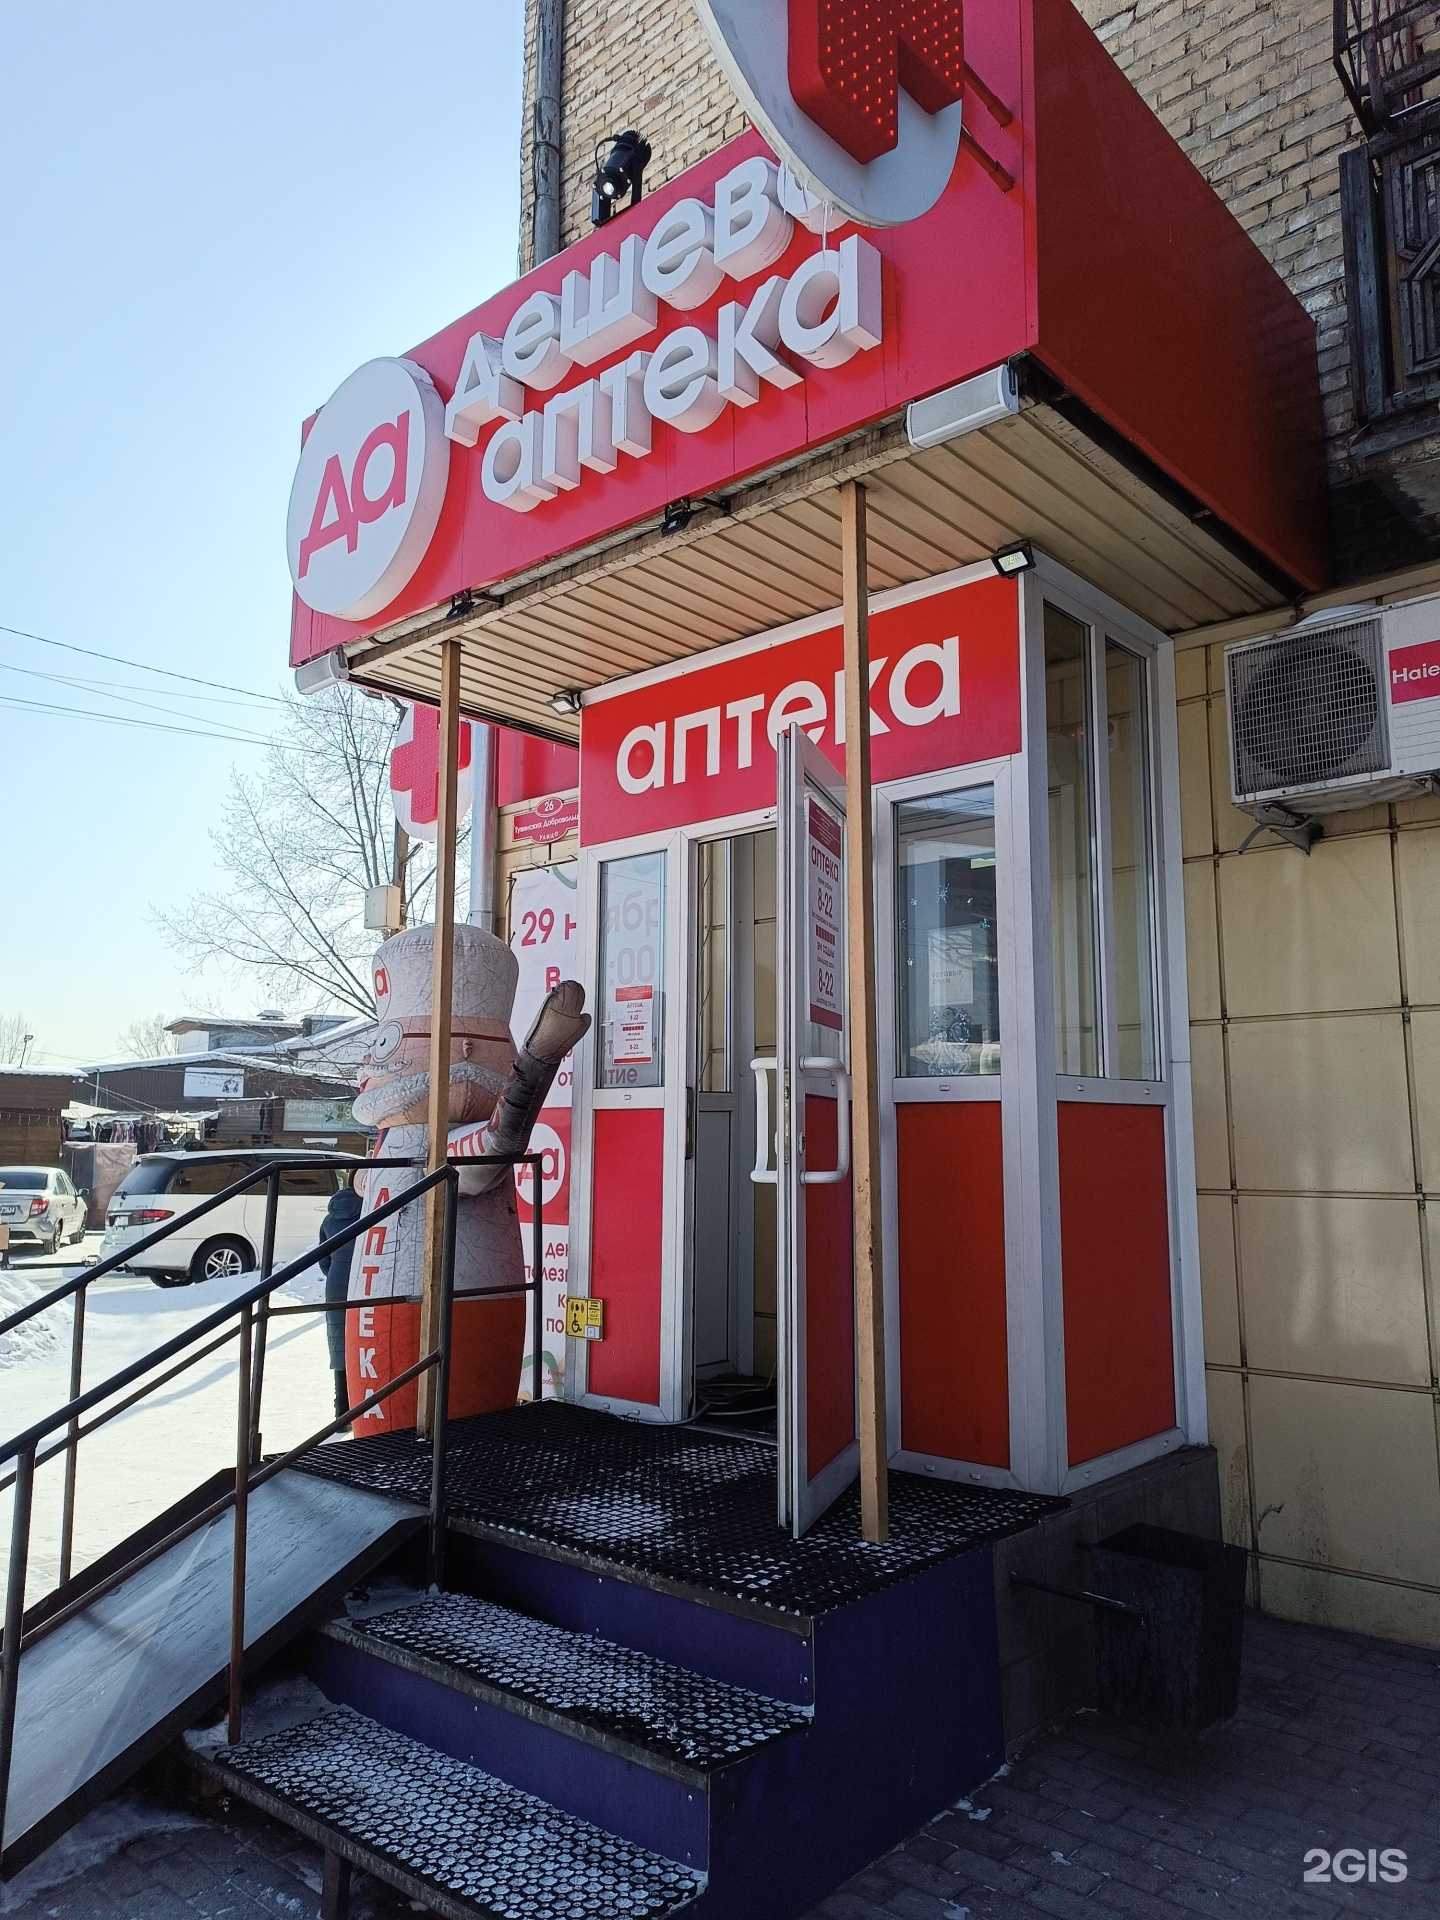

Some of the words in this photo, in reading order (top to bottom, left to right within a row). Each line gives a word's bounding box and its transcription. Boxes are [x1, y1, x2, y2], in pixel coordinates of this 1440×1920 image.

[481, 233, 881, 511] аптека
[616, 636, 961, 795] аптека
[544, 801, 554, 811] 26
[817, 888, 833, 918] 8-22
[521, 908, 555, 947] 29
[818, 968, 833, 997] 8-22
